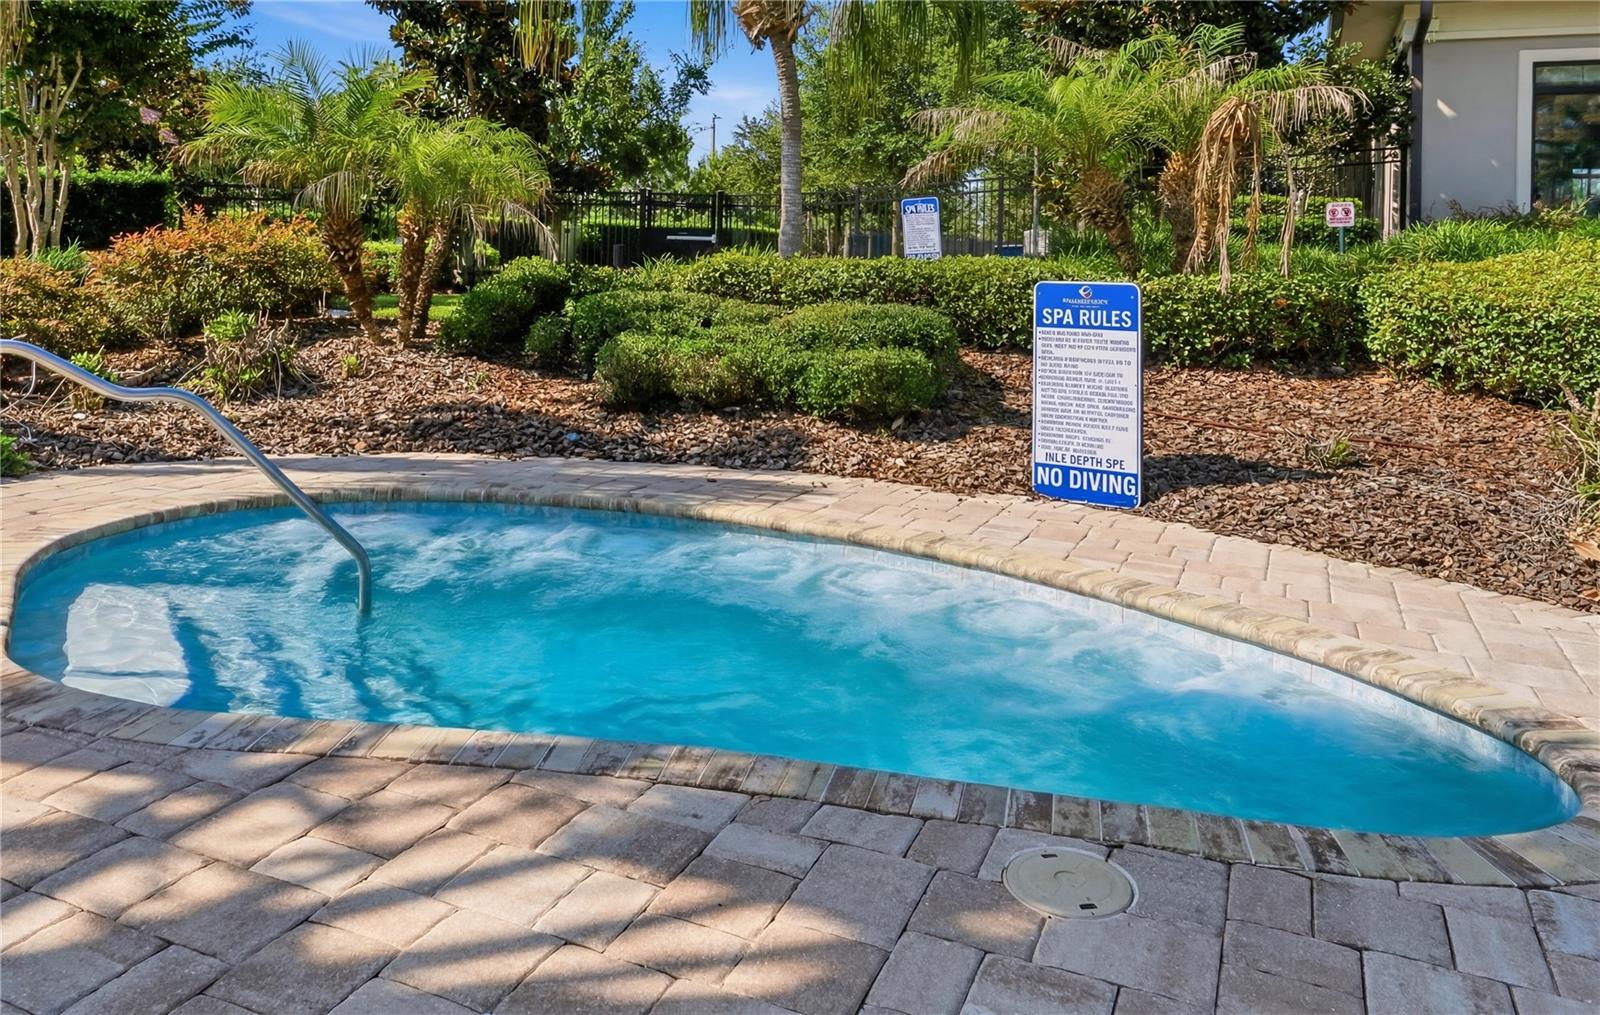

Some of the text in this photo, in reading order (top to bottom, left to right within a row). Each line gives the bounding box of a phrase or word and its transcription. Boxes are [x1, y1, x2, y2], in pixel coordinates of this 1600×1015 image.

[1042, 308, 1131, 327] SPA RULES
[1045, 452, 1125, 470] INLE DEPTH SPE
[1037, 466, 1135, 496] NO DIVING
